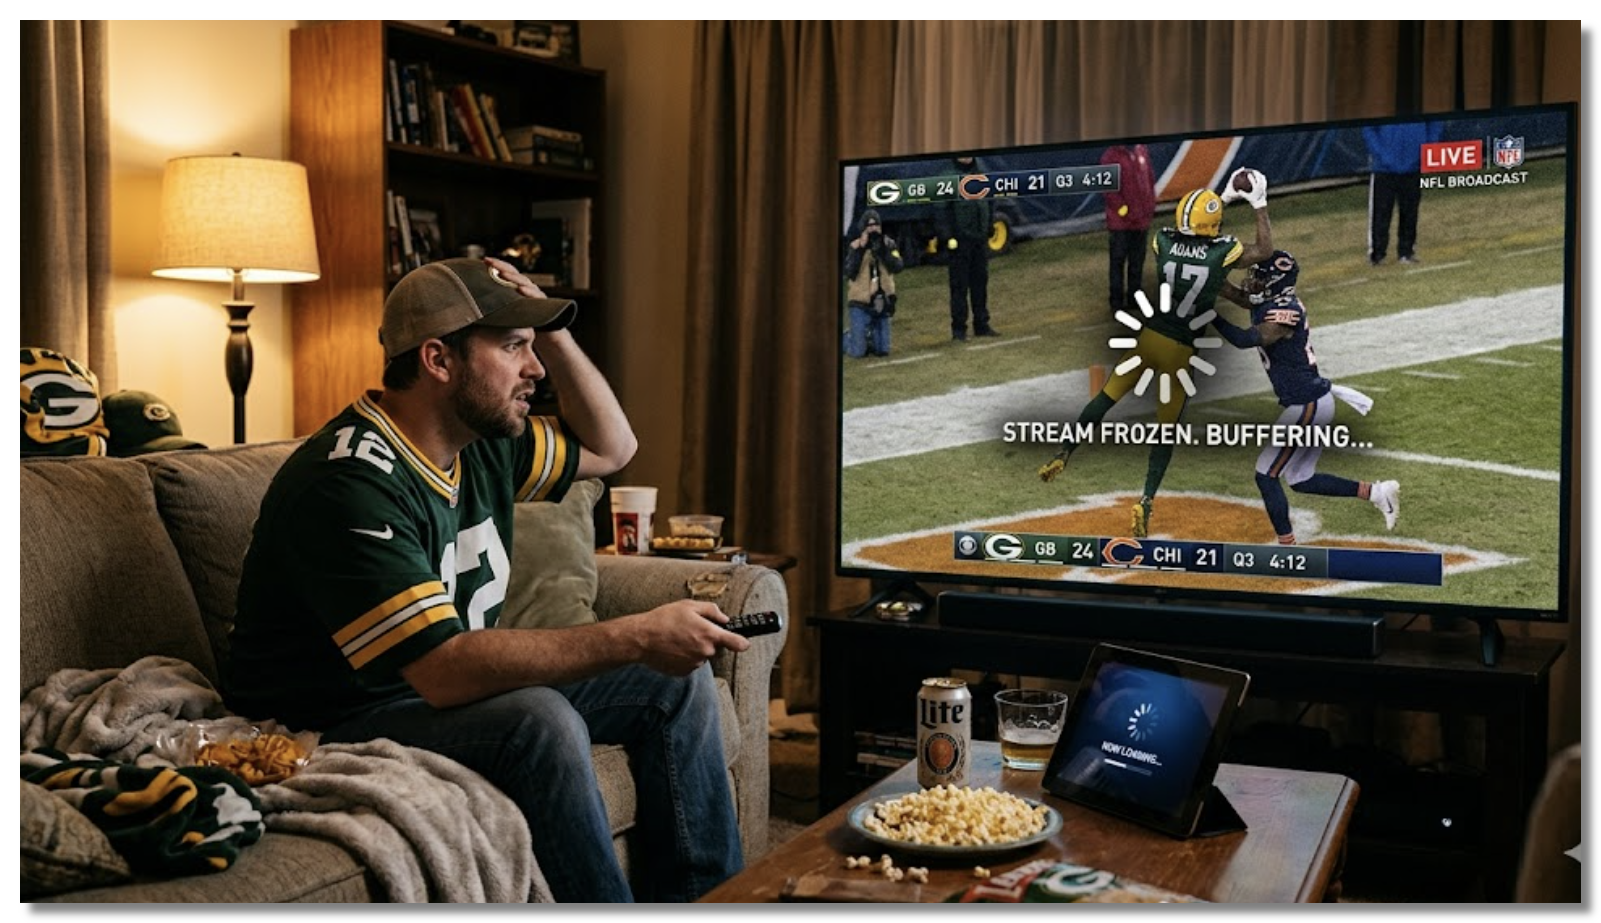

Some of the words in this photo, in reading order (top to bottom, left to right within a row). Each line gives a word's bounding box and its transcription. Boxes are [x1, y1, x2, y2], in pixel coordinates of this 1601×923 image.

[1426, 145, 1477, 167] LIVE
[869, 181, 901, 205] G
[936, 181, 954, 196] 24
[994, 177, 1019, 191] CHI
[1028, 174, 1045, 191] 21
[1082, 171, 1113, 187] 4:12
[1420, 177, 1445, 189] NFL
[1447, 171, 1529, 188] BROADCAST
[1163, 260, 1210, 316] 17
[328, 425, 397, 475] 12
[1003, 422, 1094, 443] STREAM
[1101, 423, 1200, 445] FROZEN.
[1206, 423, 1374, 448] BUFFERING...
[985, 533, 1023, 559] G
[1035, 541, 1057, 556] GB
[1072, 542, 1094, 559] 24
[1153, 547, 1182, 563] CHI
[1196, 548, 1217, 566] 21
[1233, 552, 1255, 567] Q3
[1269, 554, 1306, 570] 4:12
[920, 698, 964, 730] Lite
